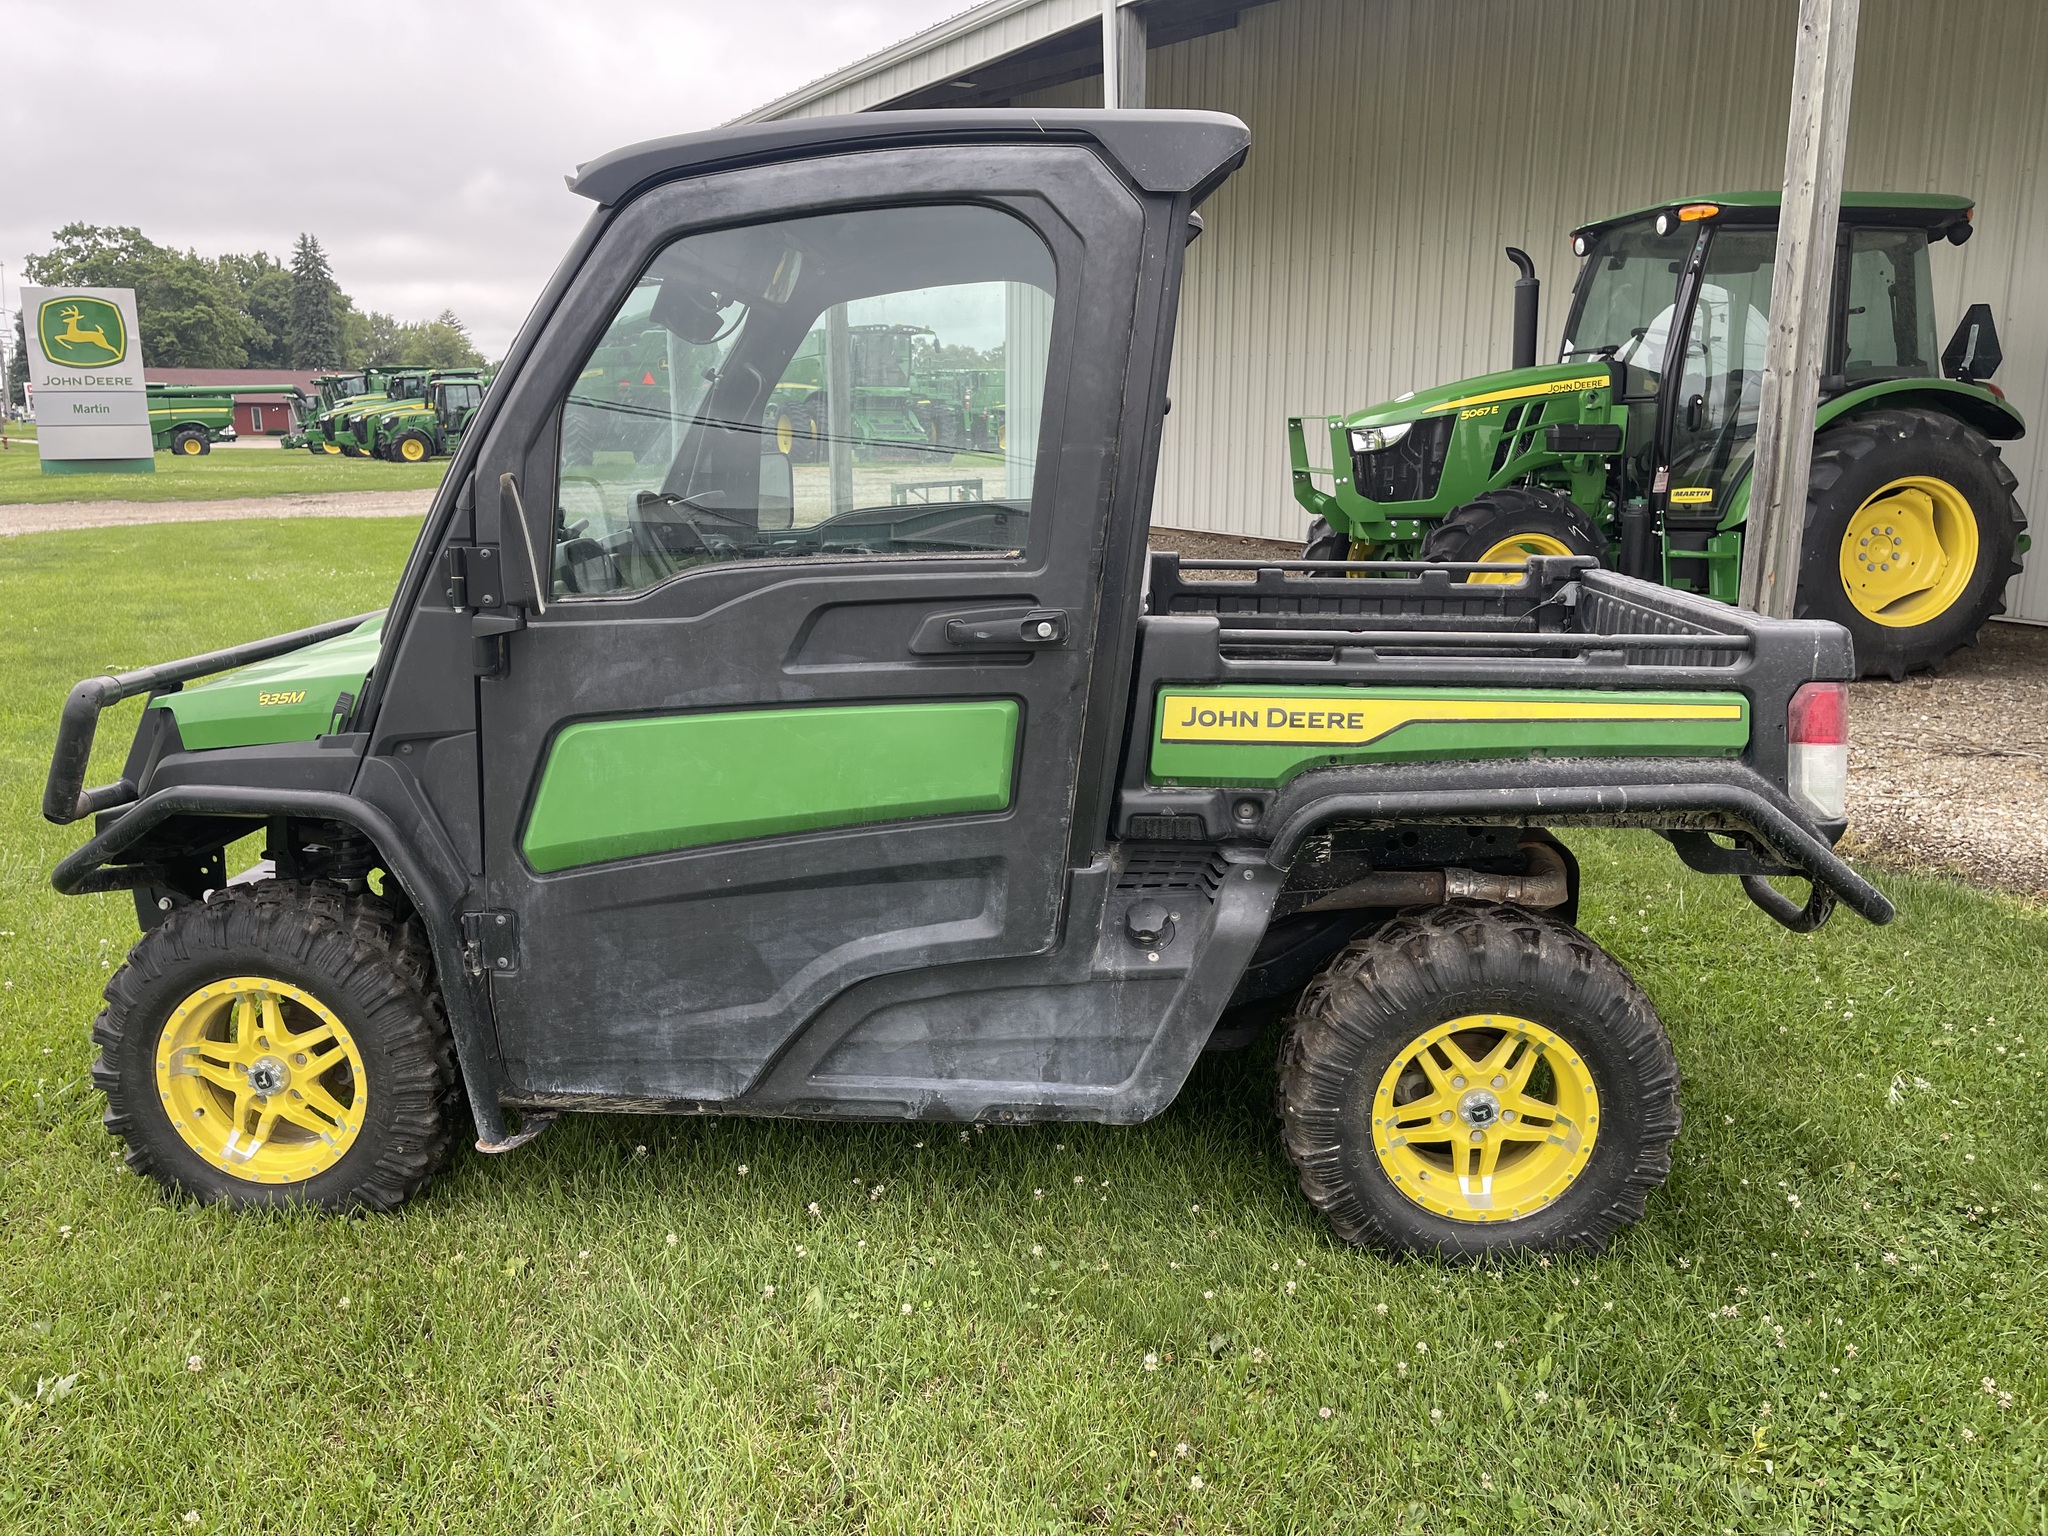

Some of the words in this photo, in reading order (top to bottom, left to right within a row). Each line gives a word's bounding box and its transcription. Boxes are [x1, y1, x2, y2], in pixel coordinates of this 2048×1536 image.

[43, 375, 82, 386] JOHN
[84, 375, 133, 386] DEERE
[1548, 383, 1573, 393] JOHN
[1574, 380, 1603, 390] DEERE
[73, 404, 110, 414] Martin
[1460, 407, 1491, 420] 5067
[259, 689, 307, 706] 835M
[1181, 706, 1259, 728] JOHN
[1266, 707, 1364, 729] DEERE
